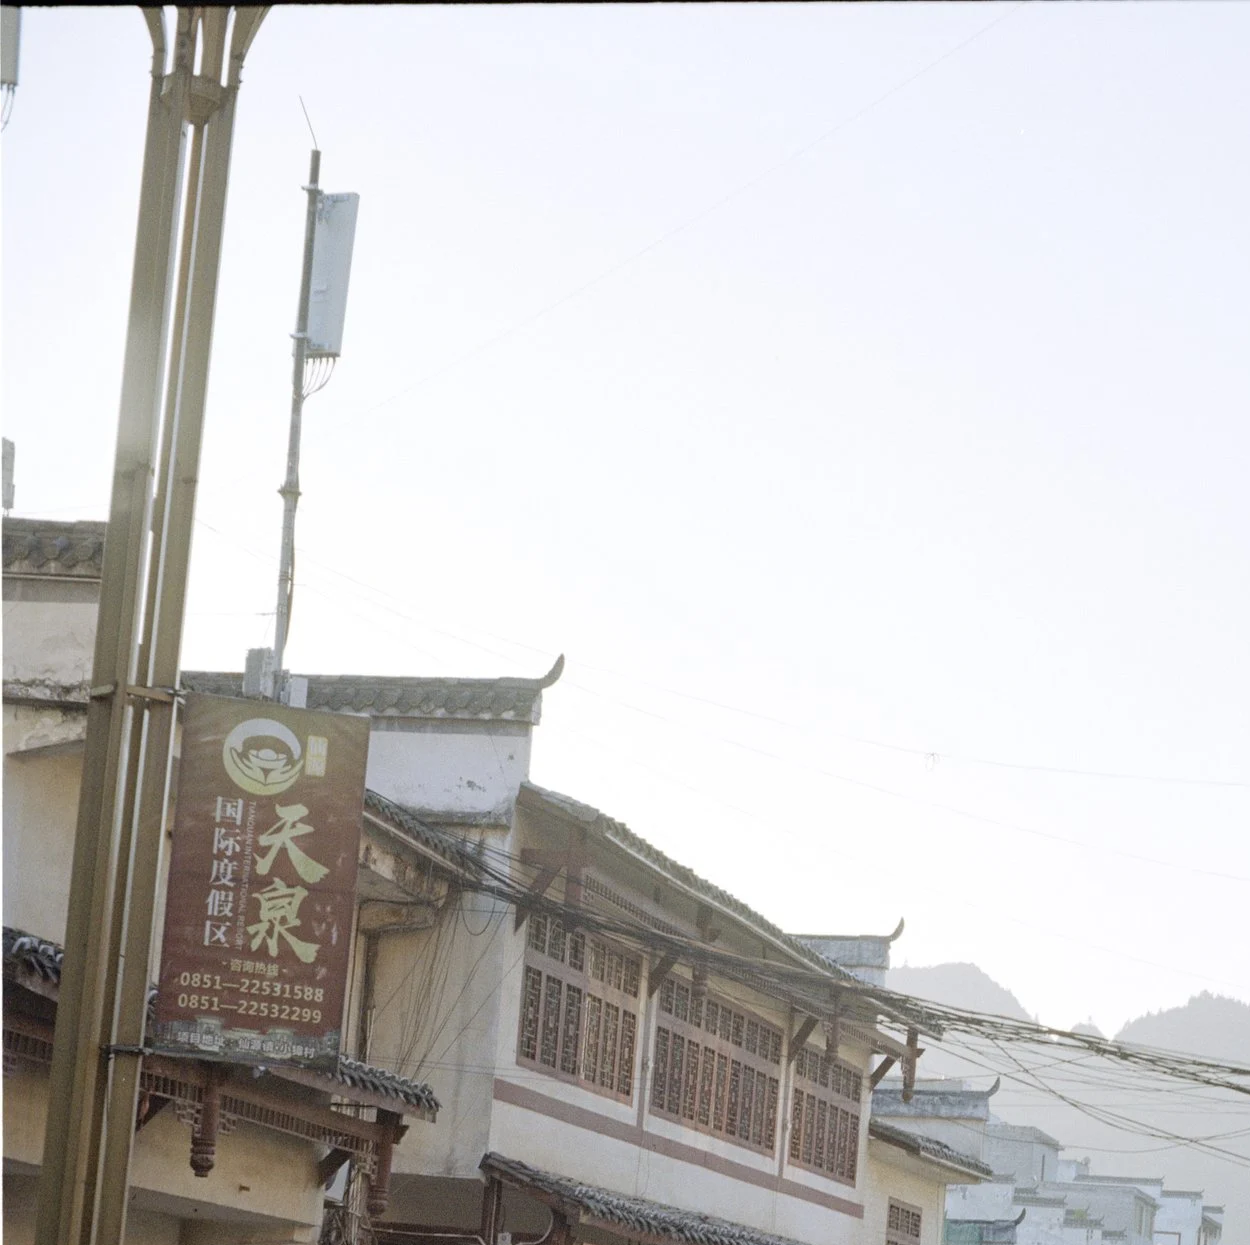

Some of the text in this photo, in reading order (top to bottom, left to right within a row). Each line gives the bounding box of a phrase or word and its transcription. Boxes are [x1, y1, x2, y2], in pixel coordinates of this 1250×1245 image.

[203, 796, 243, 948] 国际度假区
[246, 803, 330, 964] 天泉
[230, 959, 279, 977] 咨询热线
